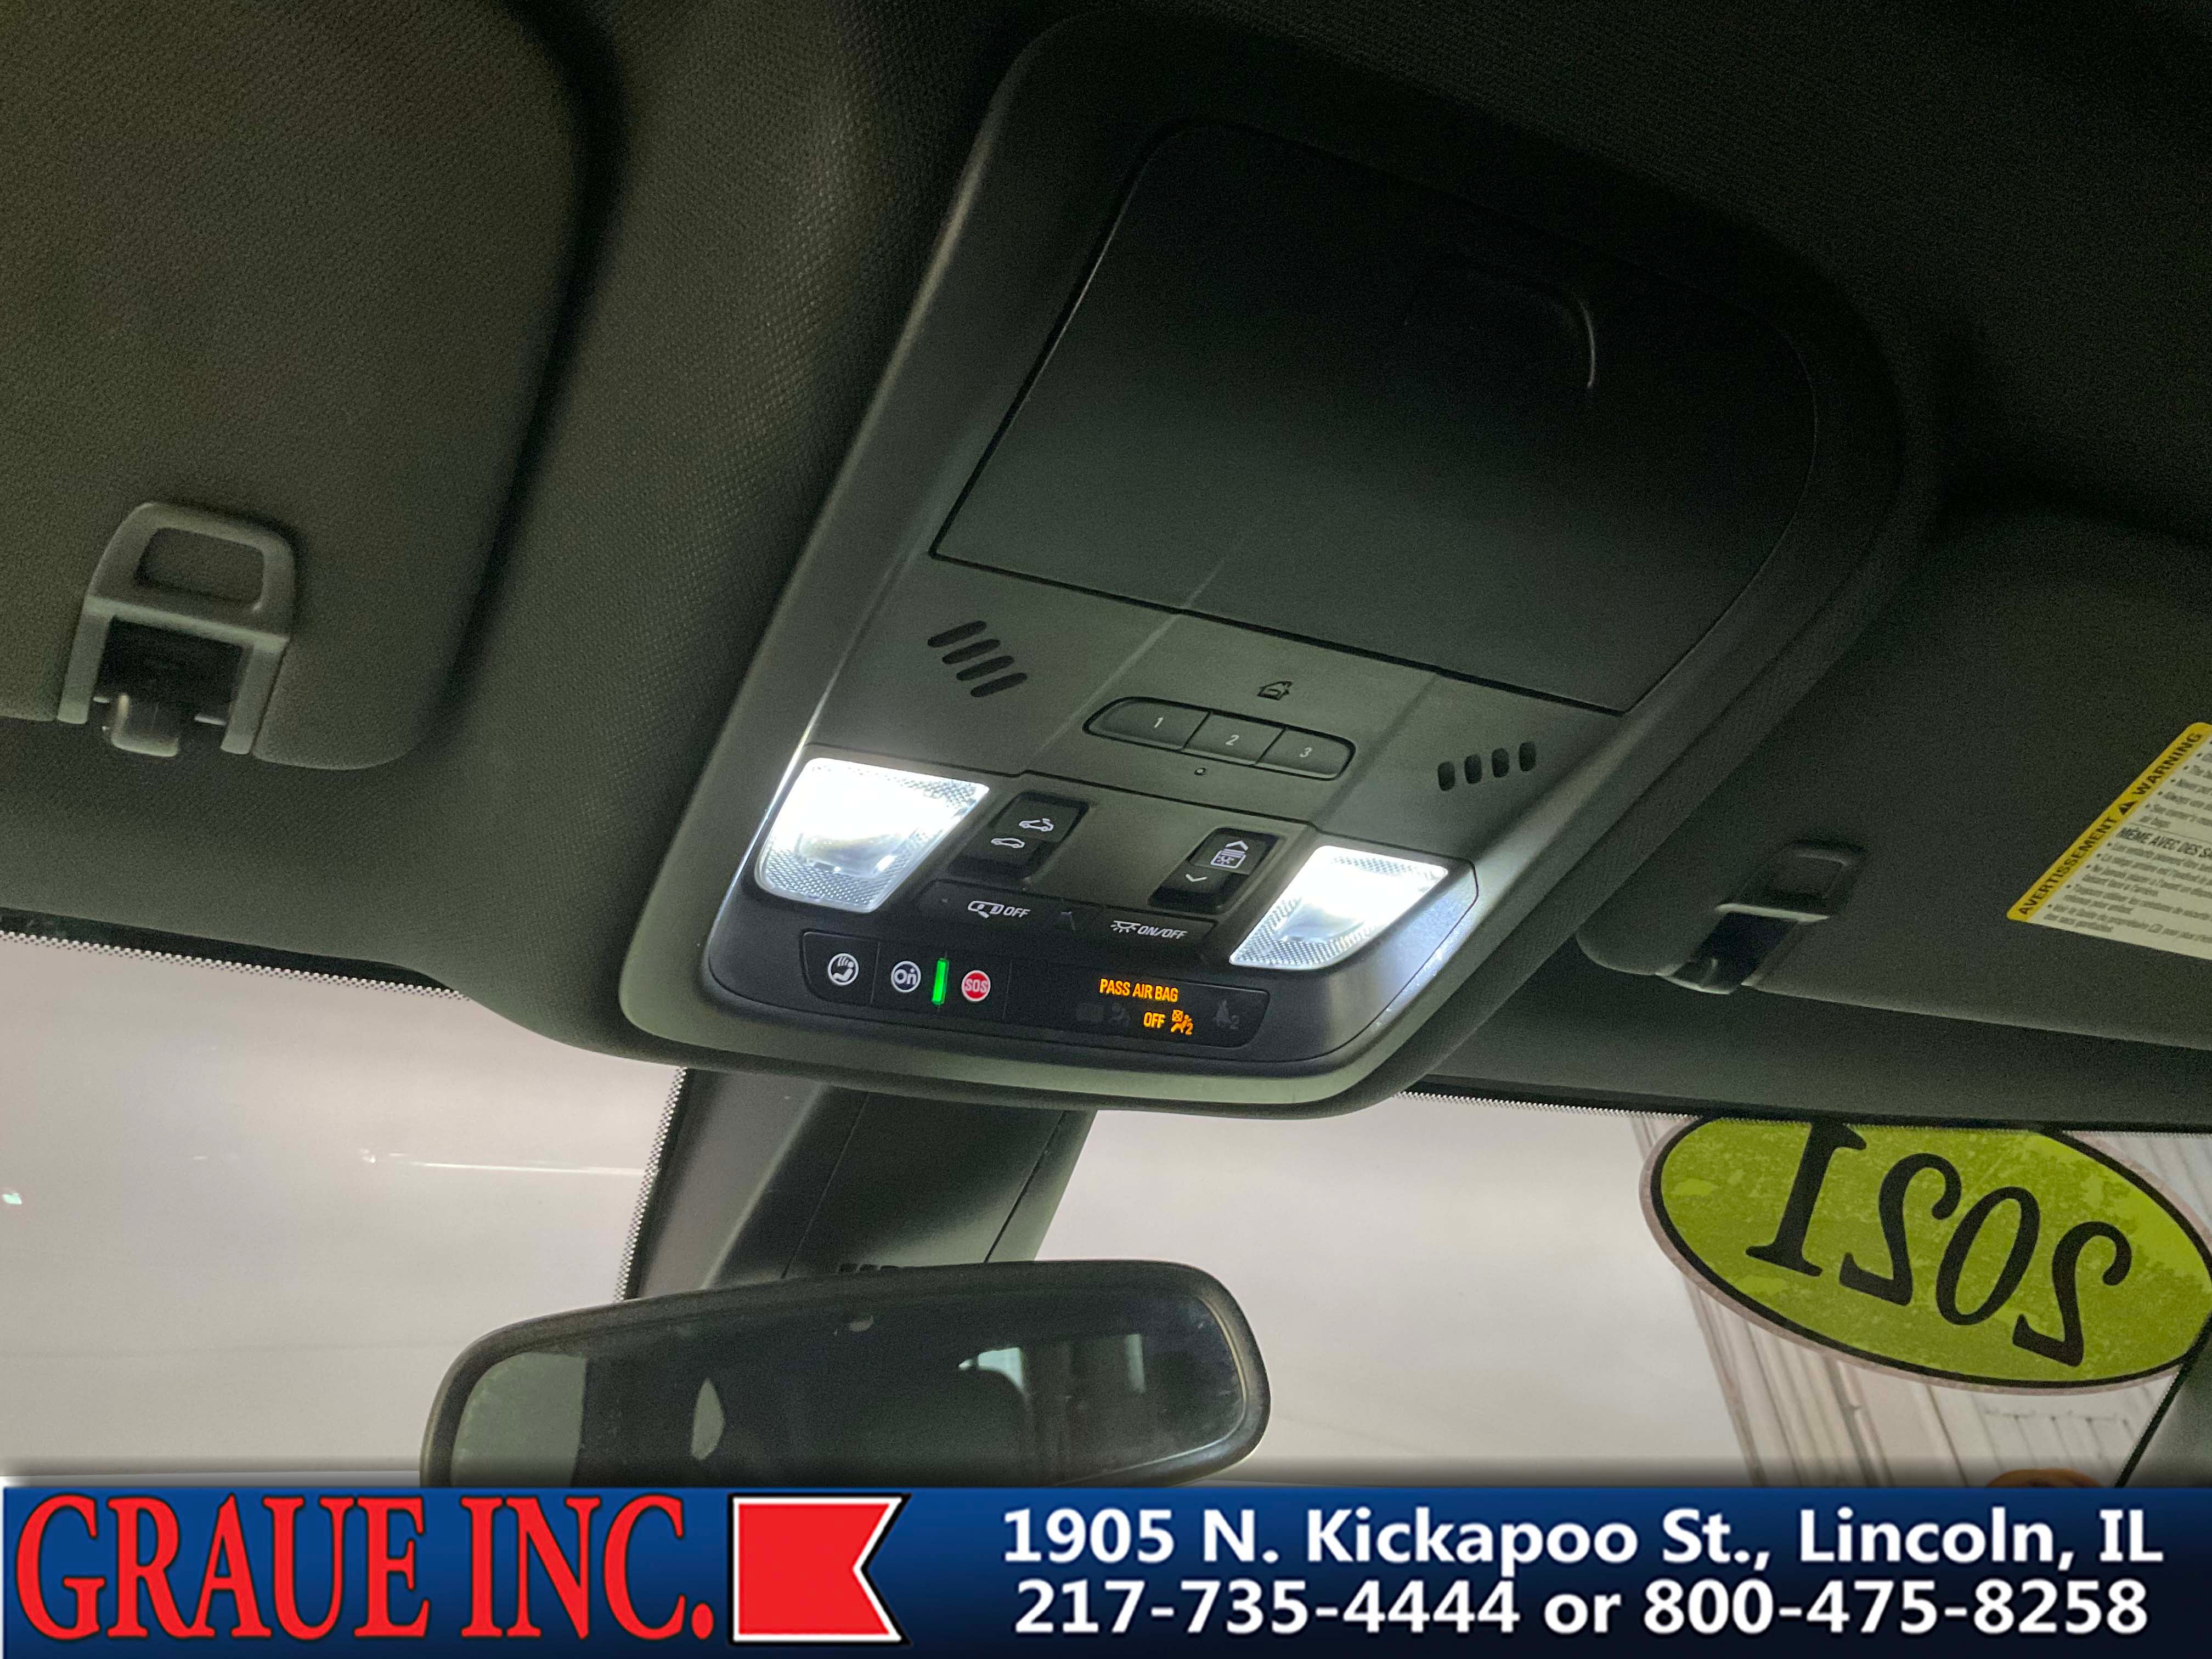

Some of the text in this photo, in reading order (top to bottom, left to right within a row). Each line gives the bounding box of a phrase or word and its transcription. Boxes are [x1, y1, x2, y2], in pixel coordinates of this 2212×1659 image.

[1154, 717, 1164, 729] 1
[1225, 735, 1239, 746] 2
[1299, 747, 1312, 758] 3
[2019, 817, 2117, 915] AVERTISSEMENT
[2132, 733, 2202, 795] WARNING
[2148, 836, 2181, 850] AVEC
[2176, 842, 2203, 856] DES
[1002, 906, 1031, 918] OFF
[1137, 925, 1188, 939] ON/OFF
[964, 978, 988, 994] SOS
[1099, 978, 1179, 1003] PASS AIR BAG
[1143, 1012, 1166, 1029] OFF
